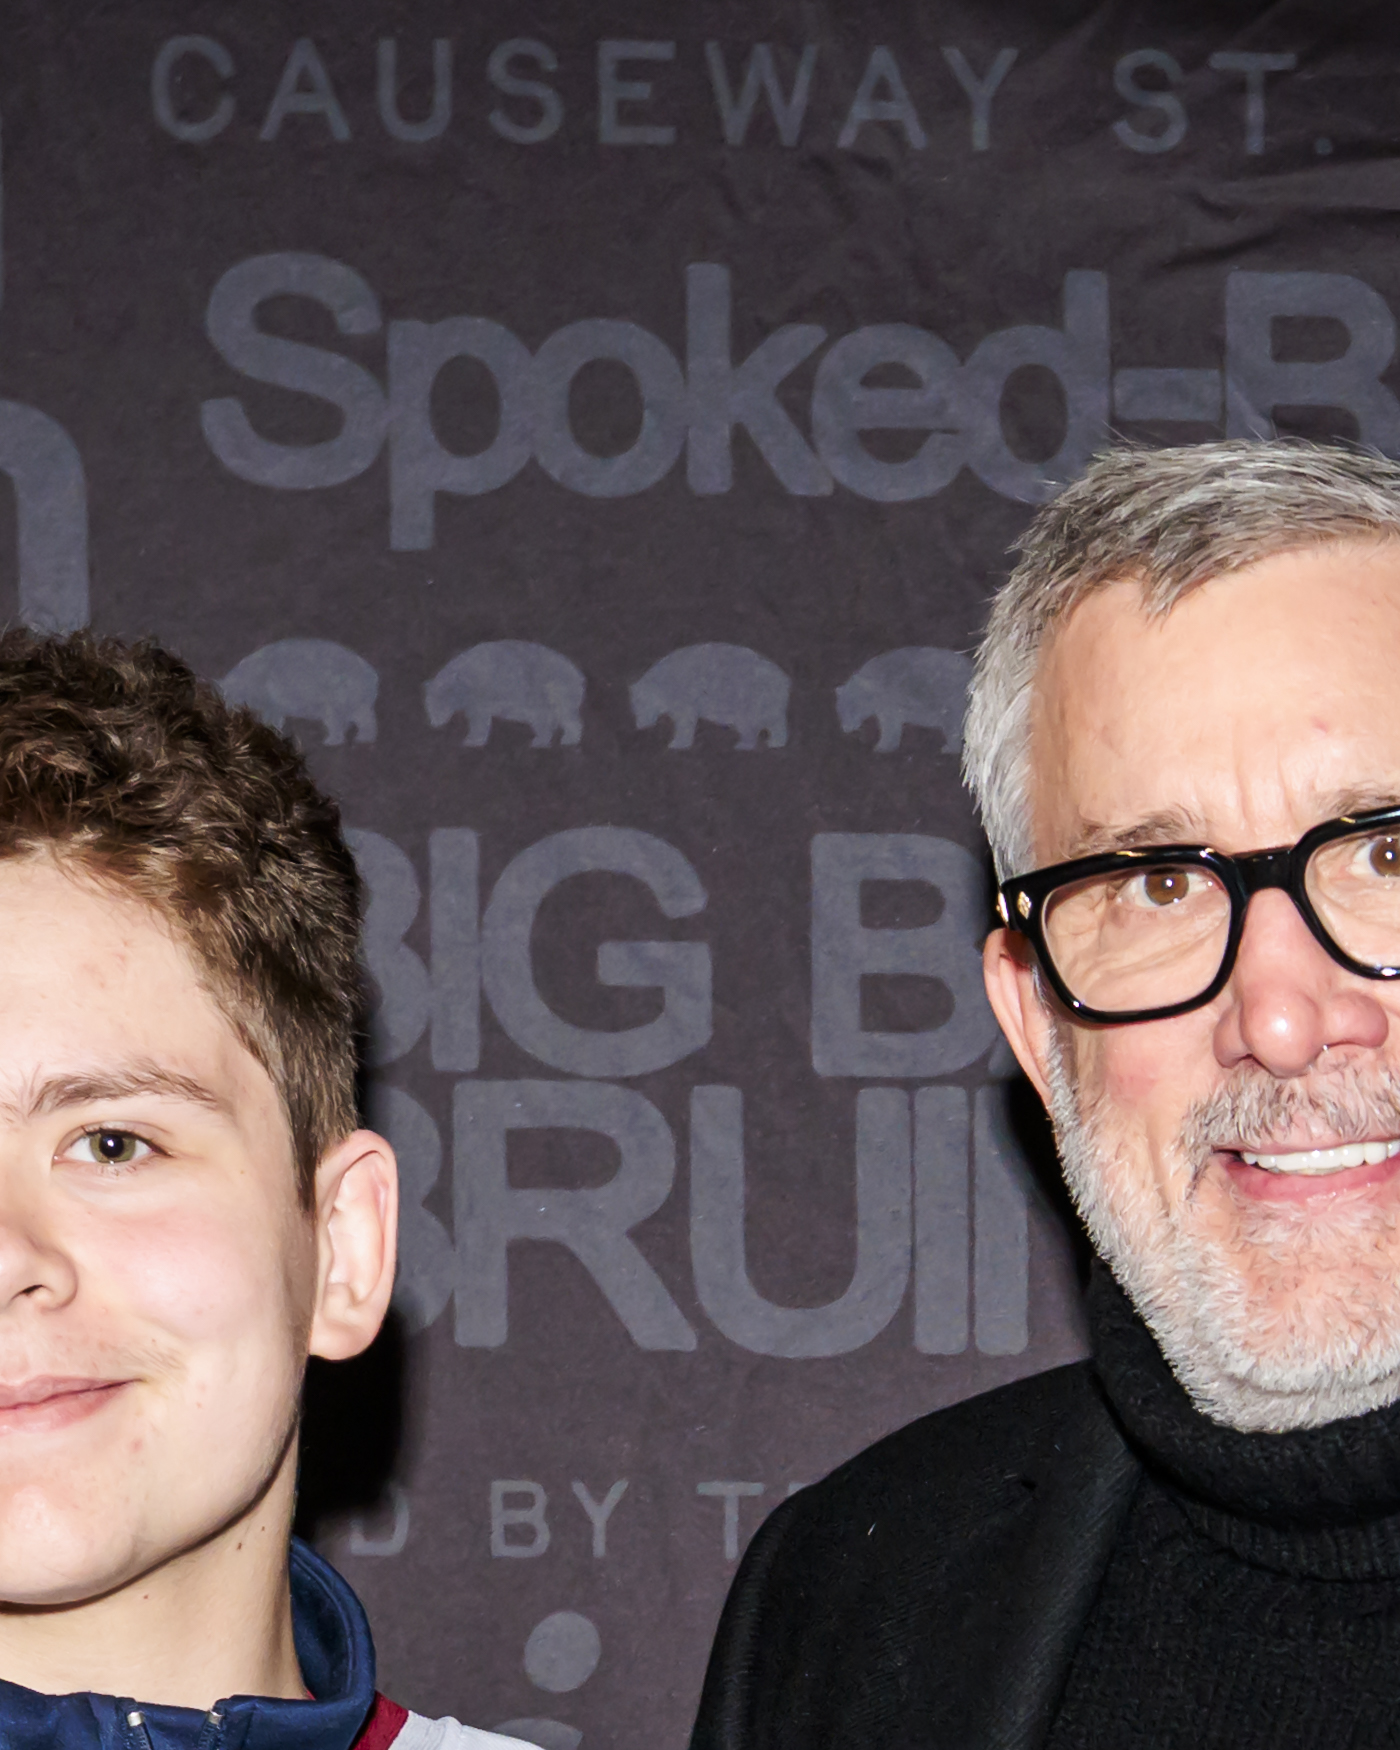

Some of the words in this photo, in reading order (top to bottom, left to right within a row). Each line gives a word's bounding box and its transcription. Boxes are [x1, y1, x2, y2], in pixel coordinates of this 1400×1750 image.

[151, 35, 1020, 154] CAUSEWAY
[1111, 48, 1337, 156] ST.
[385, 1078, 1030, 1360] RUI
[490, 1479, 628, 1558] BY
